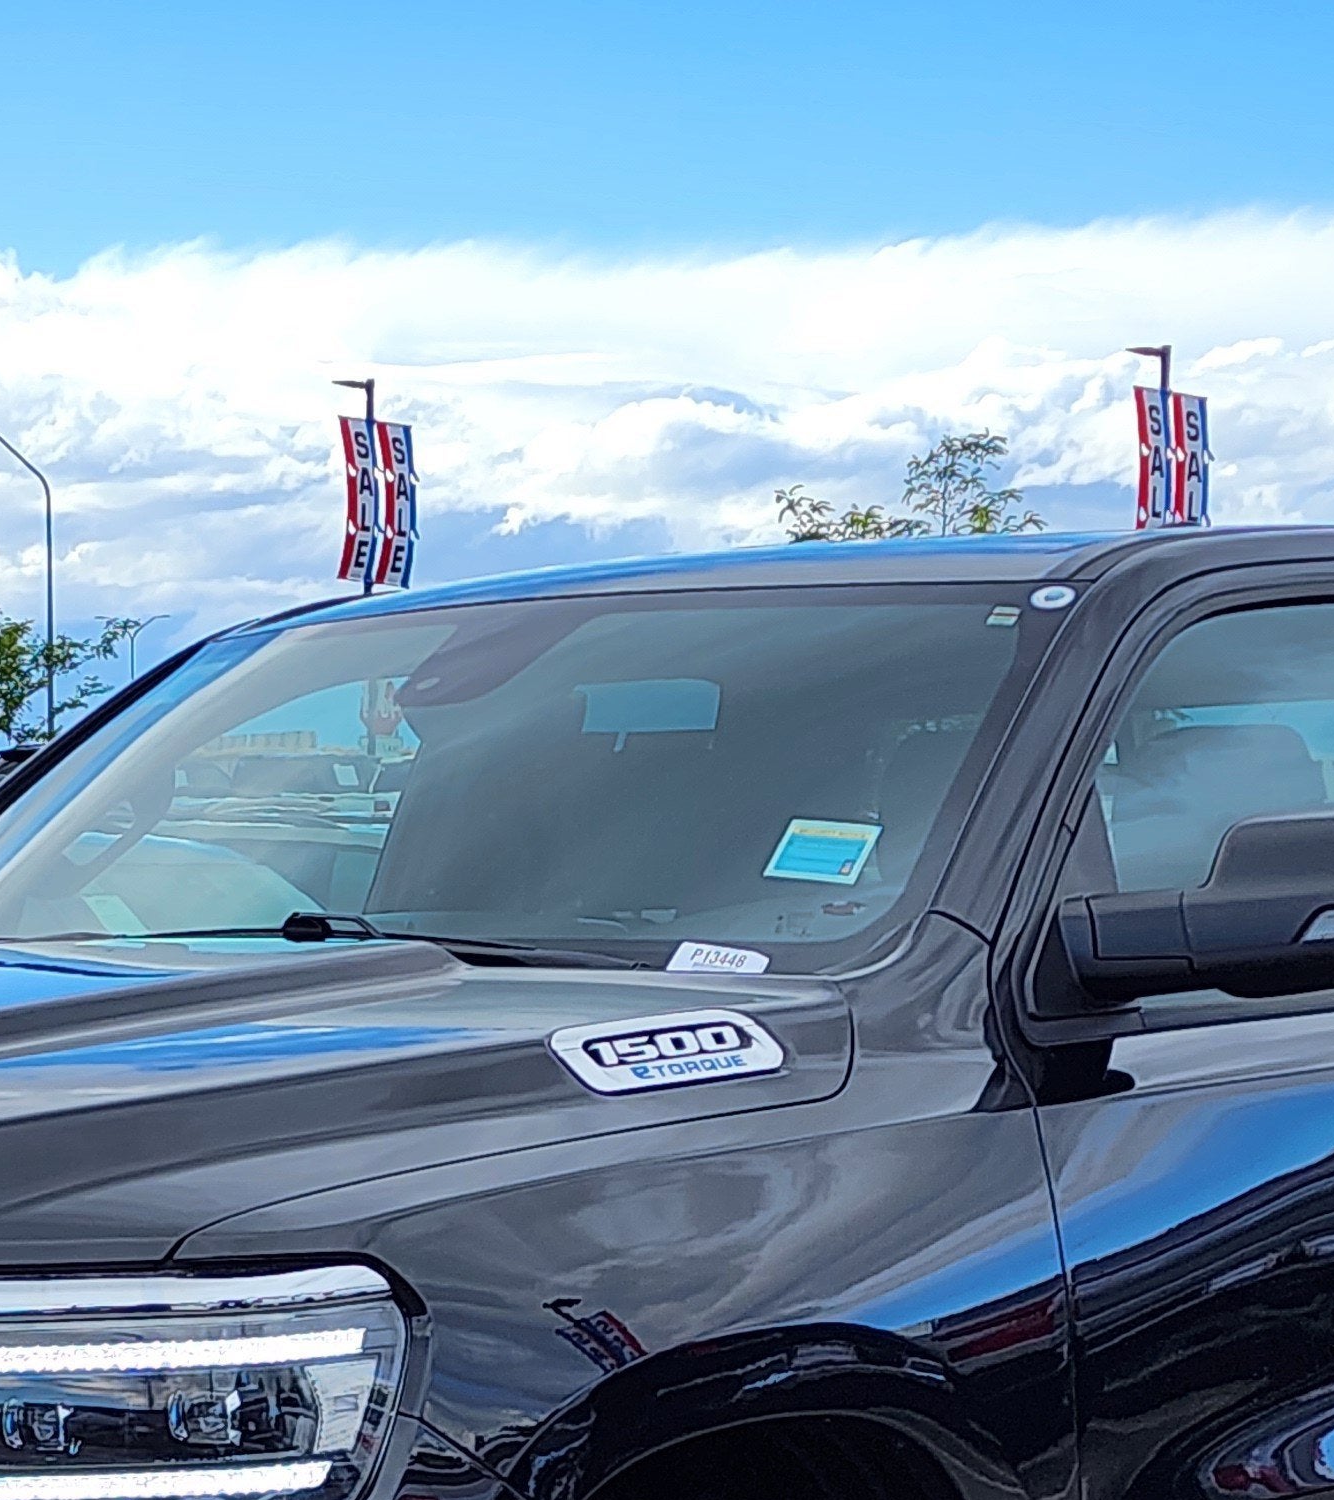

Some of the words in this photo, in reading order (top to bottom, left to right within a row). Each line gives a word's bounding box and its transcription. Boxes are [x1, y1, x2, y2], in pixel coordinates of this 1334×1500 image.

[354, 430, 373, 568] SALE
[390, 437, 410, 573] SALE
[1148, 404, 1164, 518] SAL
[1186, 410, 1202, 522] SAL
[690, 948, 748, 968] P13448
[587, 1025, 742, 1066] 1500
